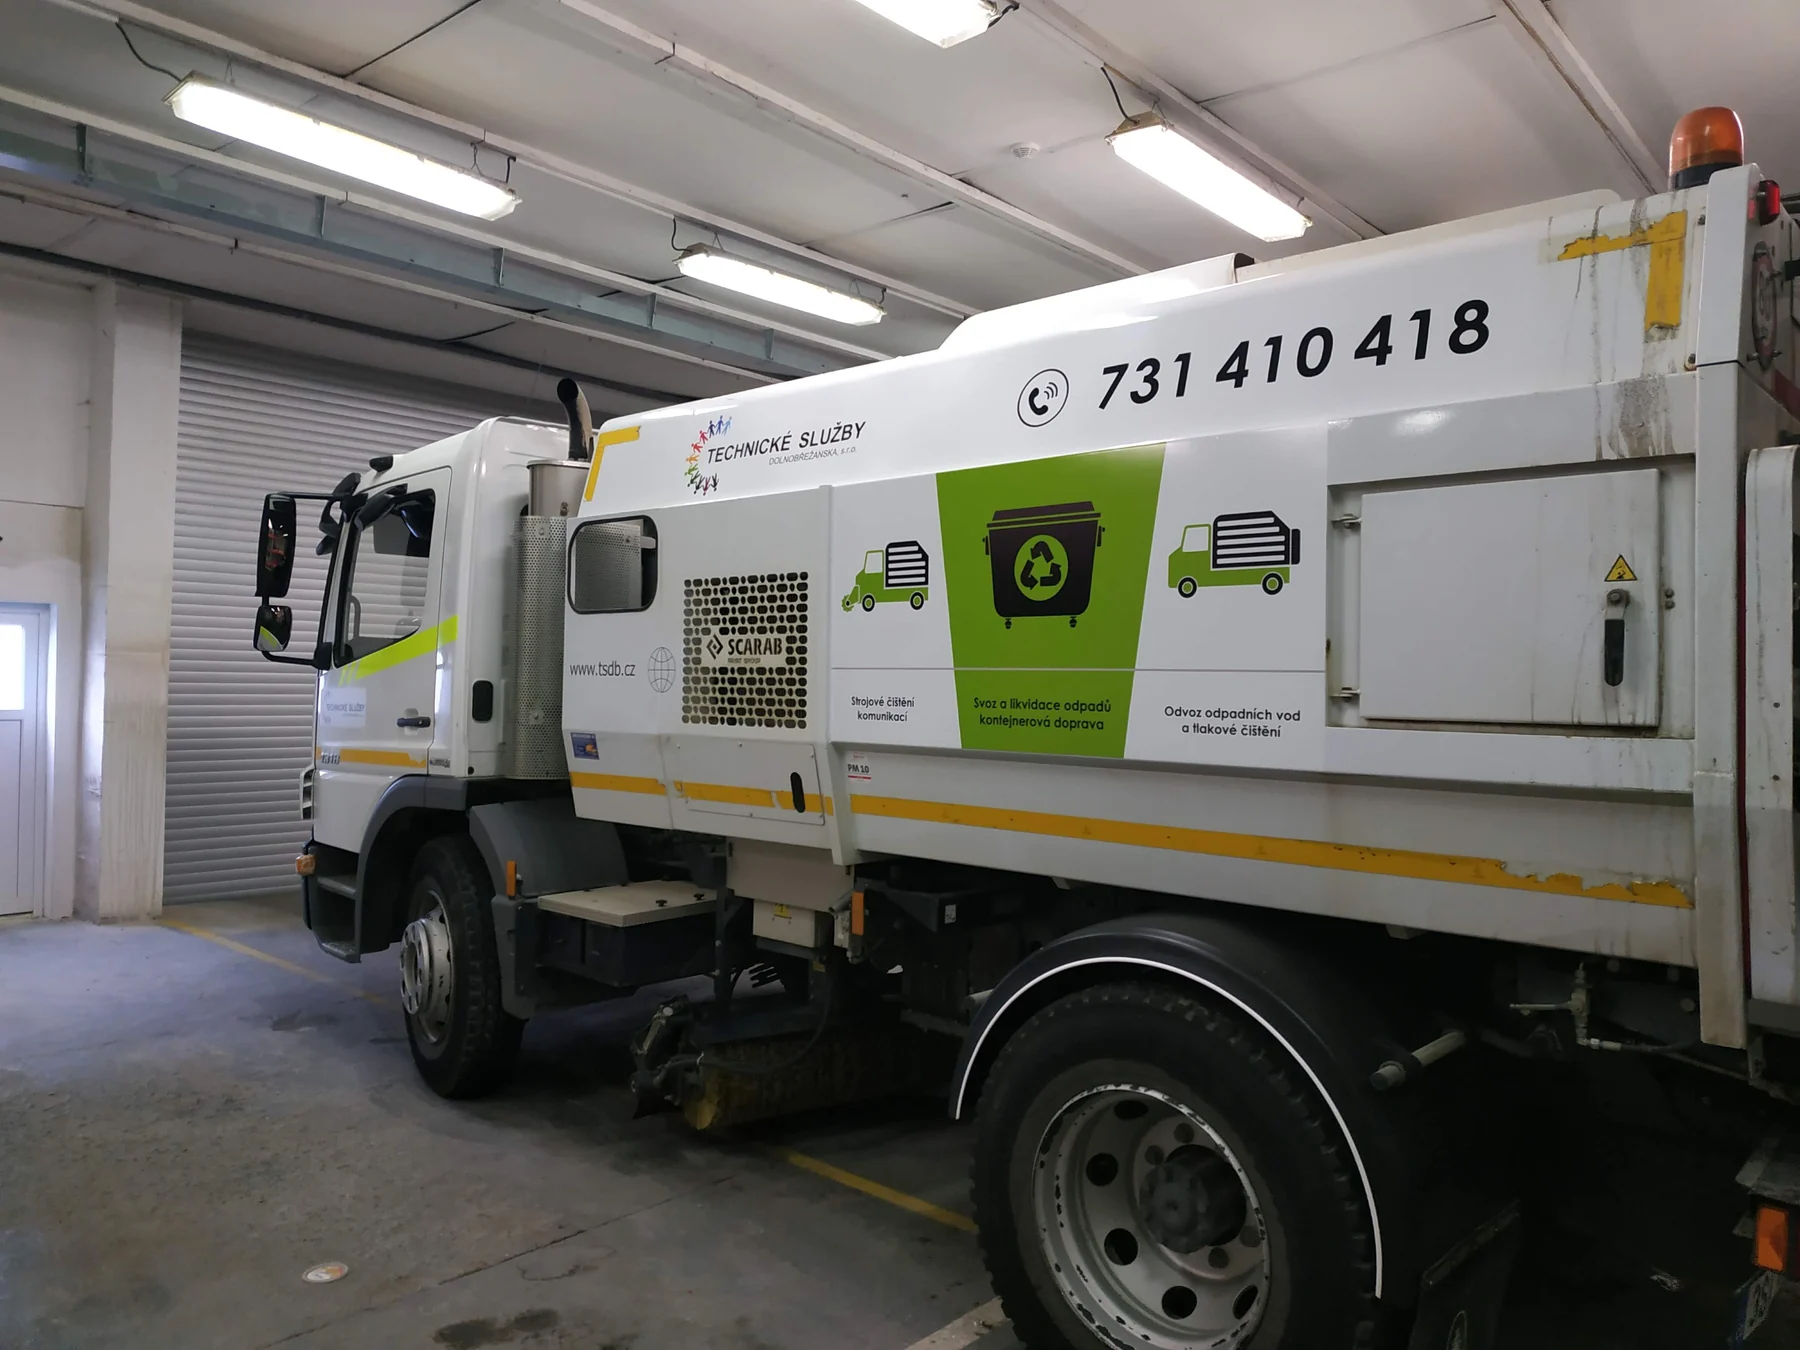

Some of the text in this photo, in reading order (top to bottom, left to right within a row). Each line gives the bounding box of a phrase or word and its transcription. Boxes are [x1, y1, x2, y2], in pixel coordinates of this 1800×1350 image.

[1099, 299, 1490, 410] 731 410 418
[707, 421, 866, 464] TECHNICKÉ SLUŽBY
[727, 637, 783, 656] SCARAB
[569, 661, 636, 677] www.tsdb.cz
[851, 696, 915, 708] Strojové čištění
[973, 697, 1112, 714] Svoz a likvidace odpadů
[857, 710, 908, 722] komunikací
[1164, 706, 1301, 721] Odvoz odpadních vod
[979, 714, 1104, 731] kontejnerová doprava
[1181, 723, 1281, 738] a tlakové čištění
